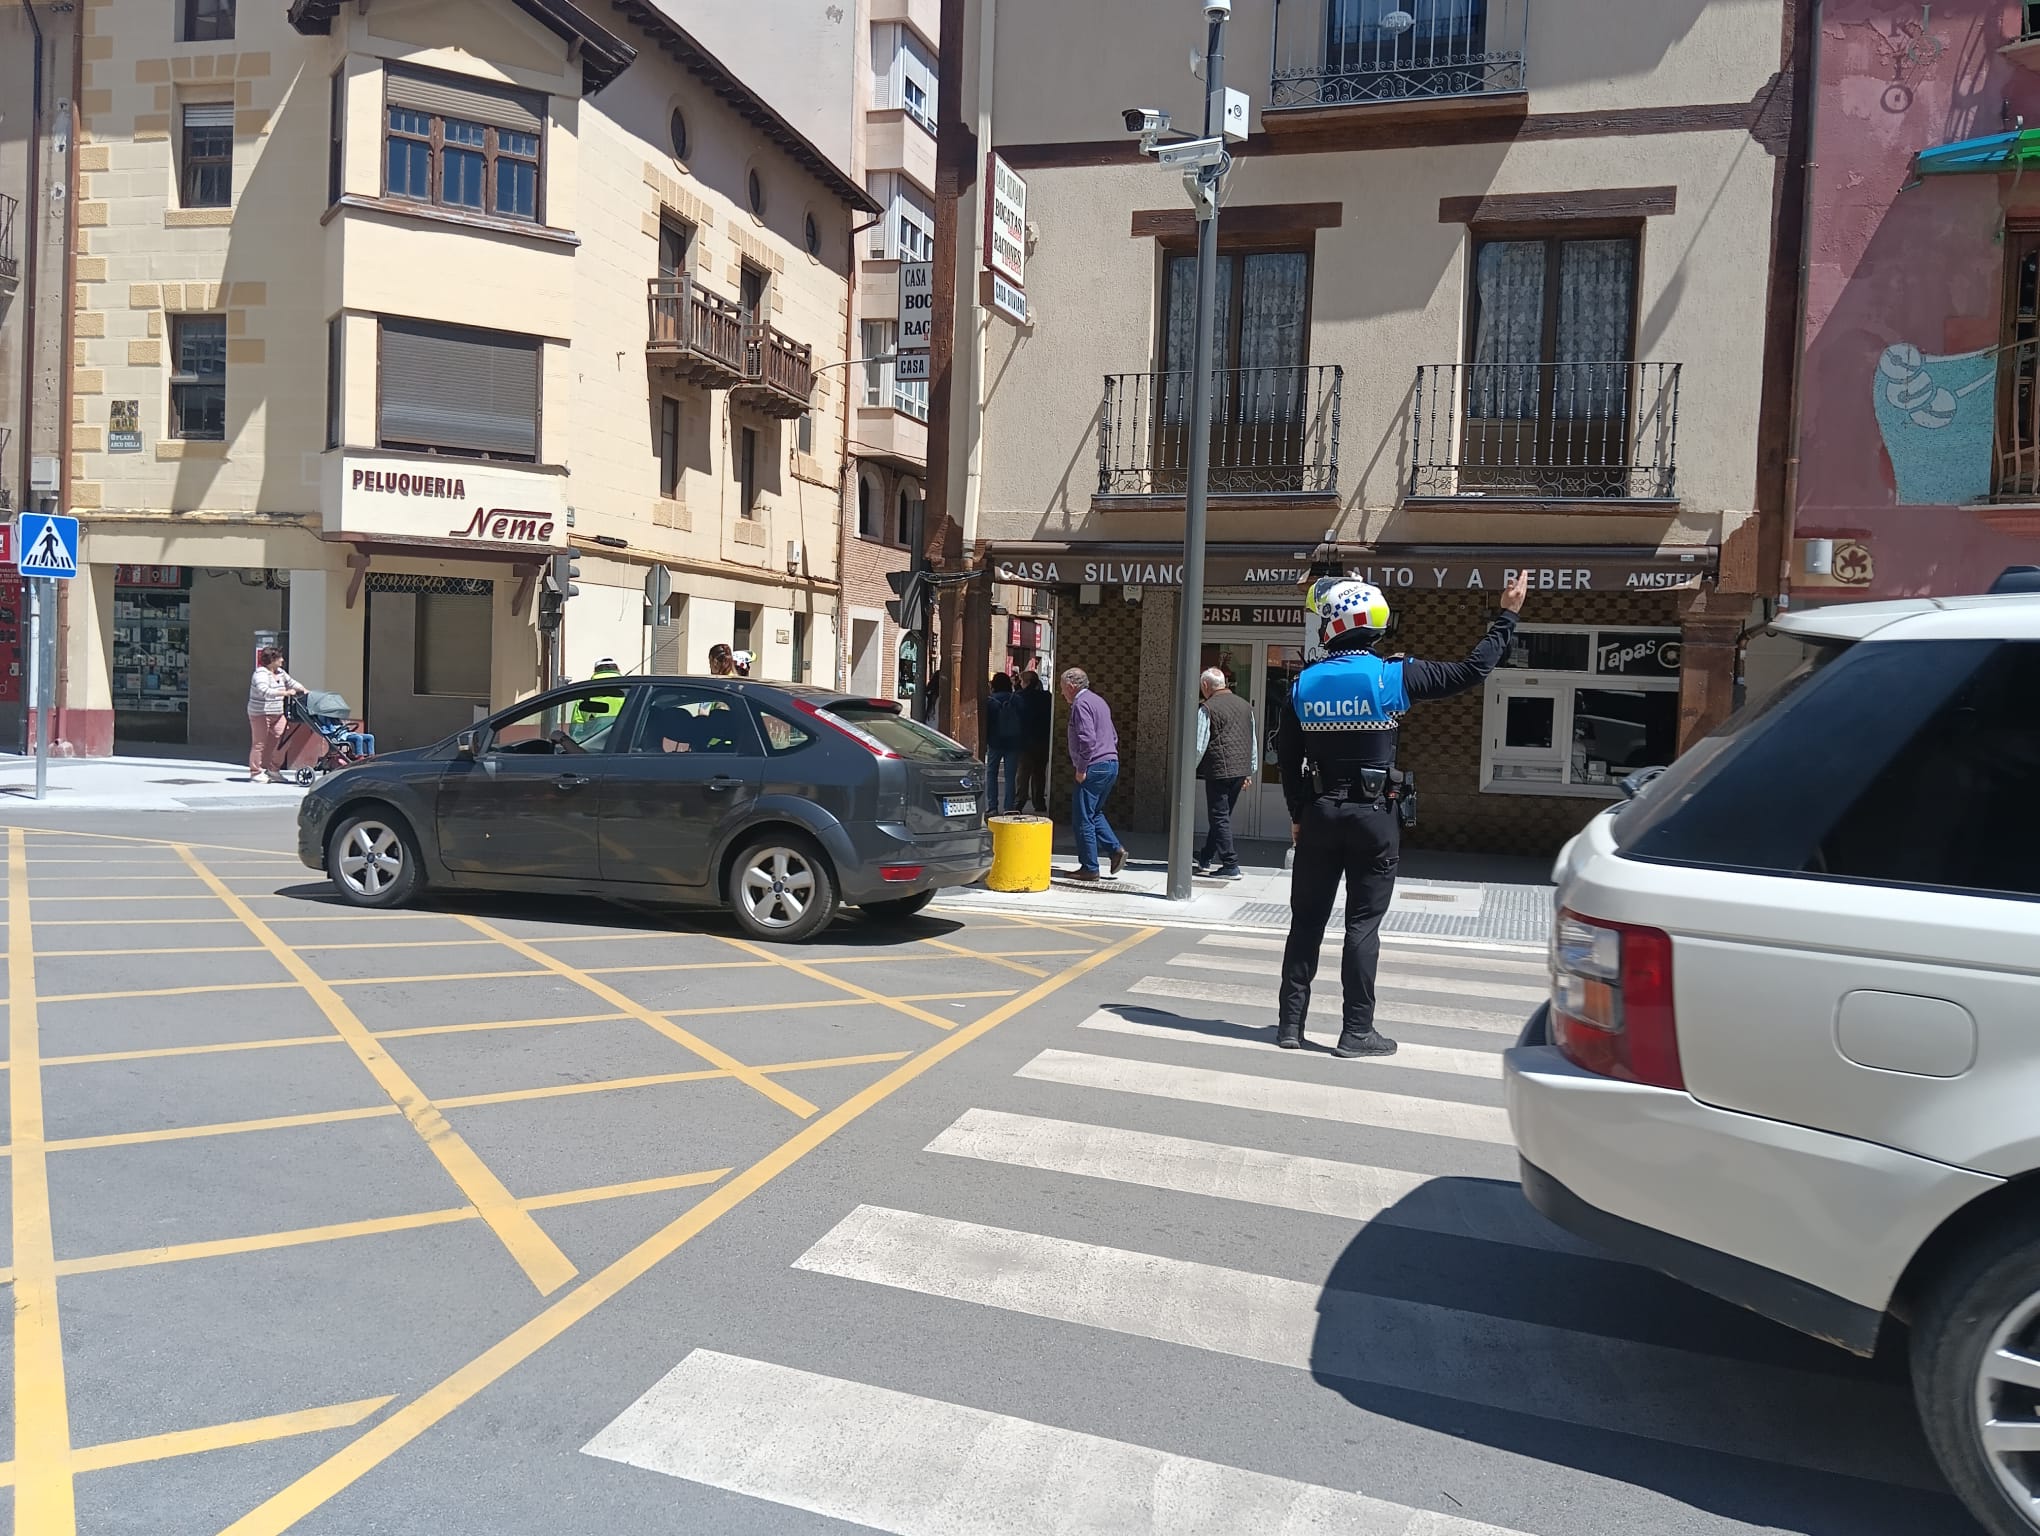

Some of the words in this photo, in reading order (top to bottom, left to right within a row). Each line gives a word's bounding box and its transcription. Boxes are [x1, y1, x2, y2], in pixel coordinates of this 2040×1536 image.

[995, 198, 1023, 235] BOCATAS
[994, 231, 1022, 268] RACIONES
[905, 268, 926, 287] CASA
[995, 281, 1006, 304] CASA
[900, 359, 925, 374] CASA
[352, 468, 466, 500] PELUQUERIA
[449, 506, 555, 542] Neme
[1000, 561, 1060, 582] CASA
[1433, 567, 1449, 588] Y
[1466, 568, 1484, 589] A
[1503, 568, 1592, 590] BEBER
[1203, 607, 1241, 622] CASA
[1252, 608, 1306, 623] SILVIA
[1598, 640, 1656, 672] Tapas
[1303, 695, 1373, 718] POLICÍA
